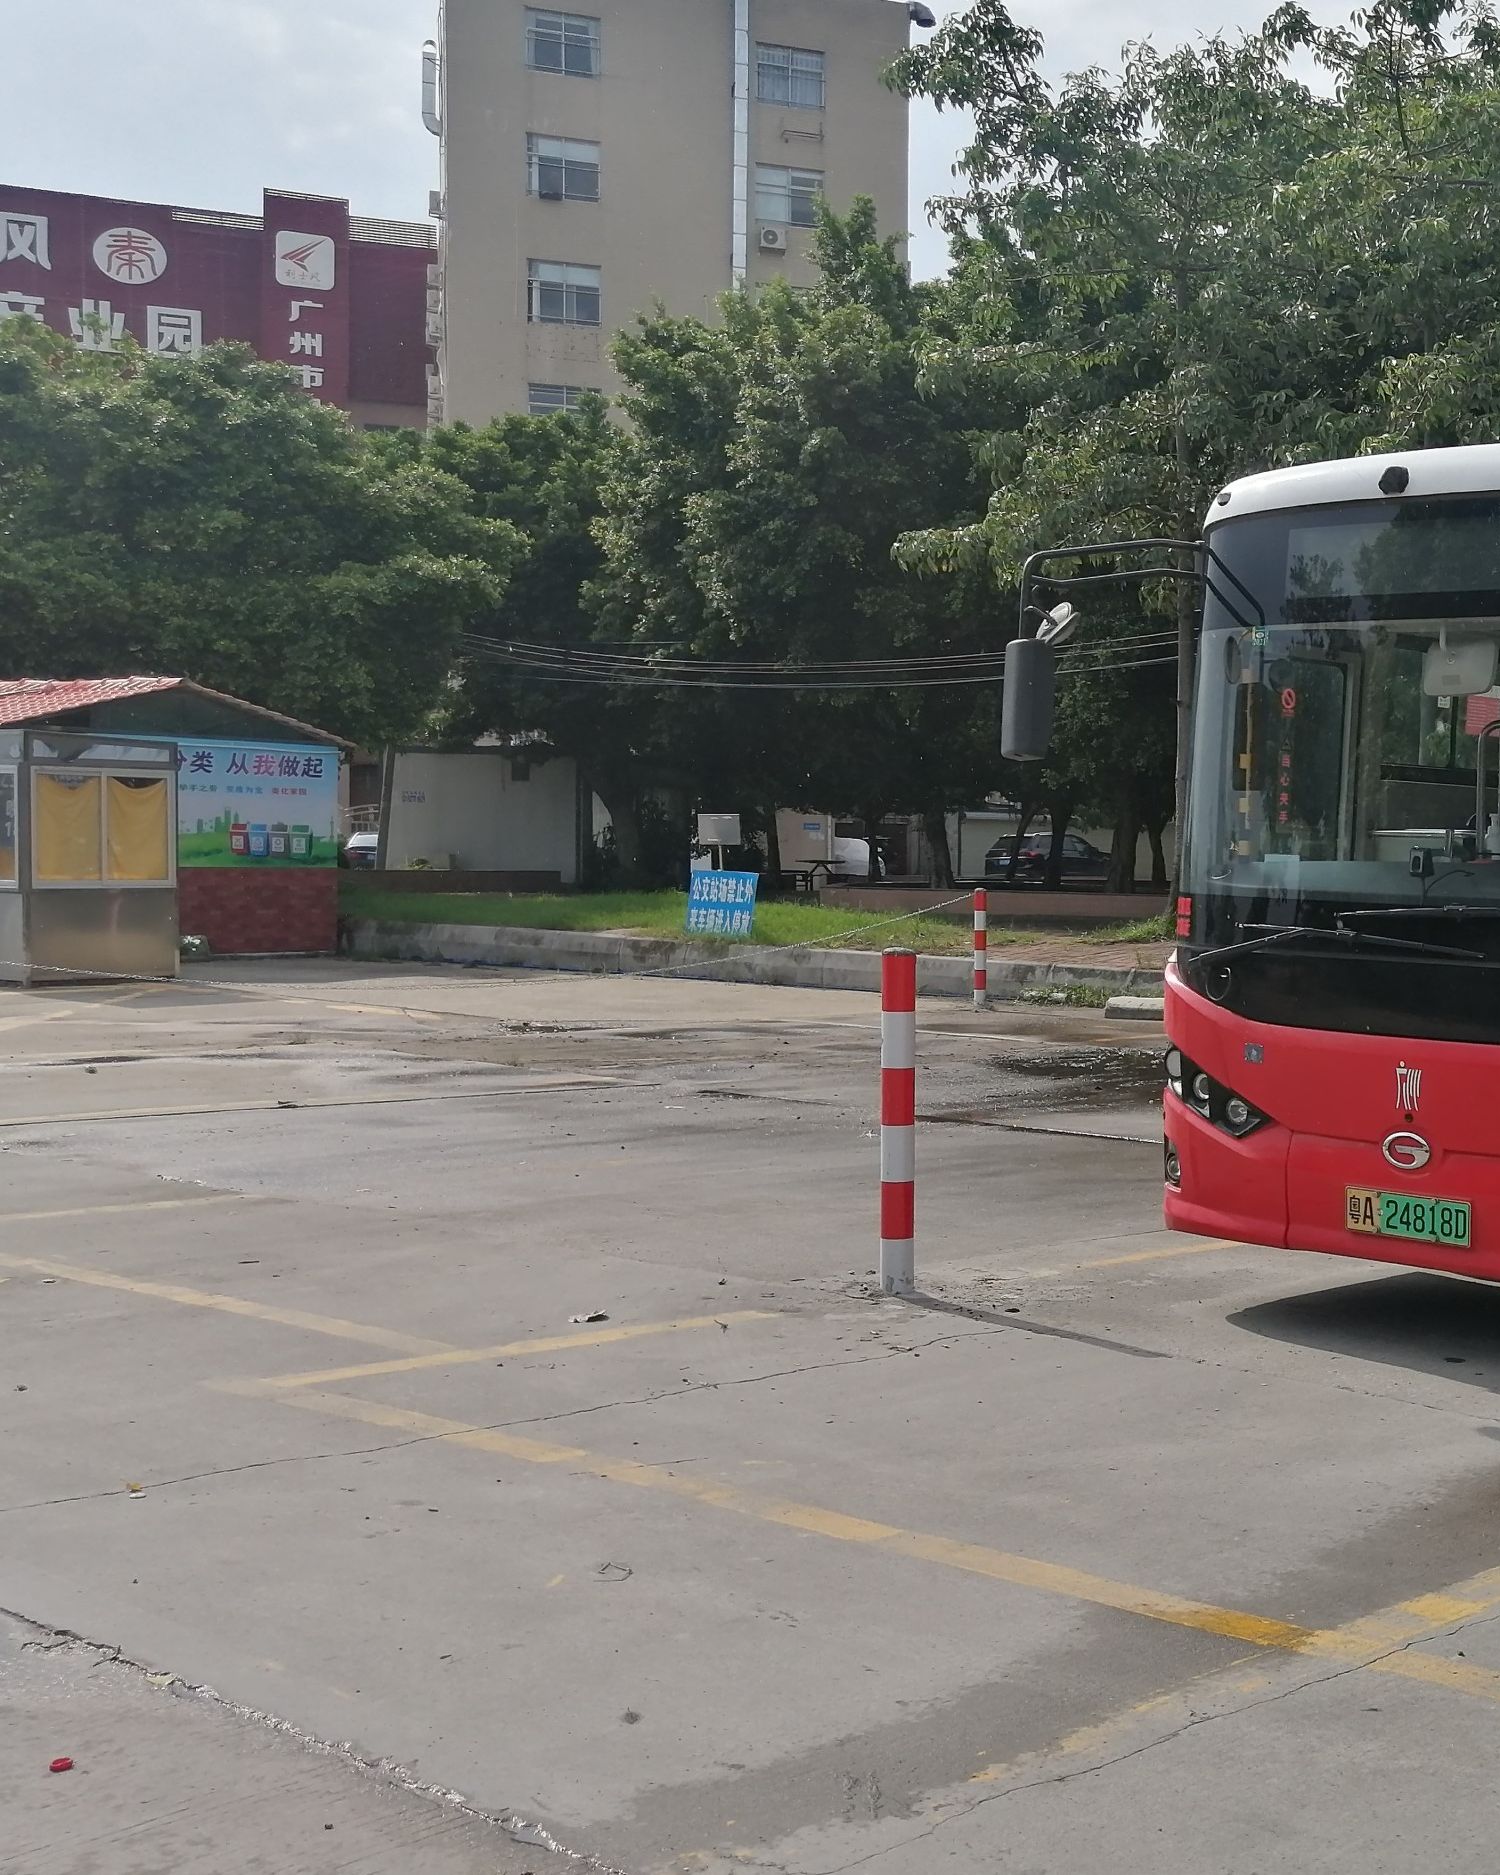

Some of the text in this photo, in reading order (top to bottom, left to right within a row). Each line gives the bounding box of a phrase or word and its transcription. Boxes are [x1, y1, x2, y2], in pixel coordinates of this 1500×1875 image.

[288, 300, 325, 406] 广州市
[226, 752, 323, 778] 从我做起
